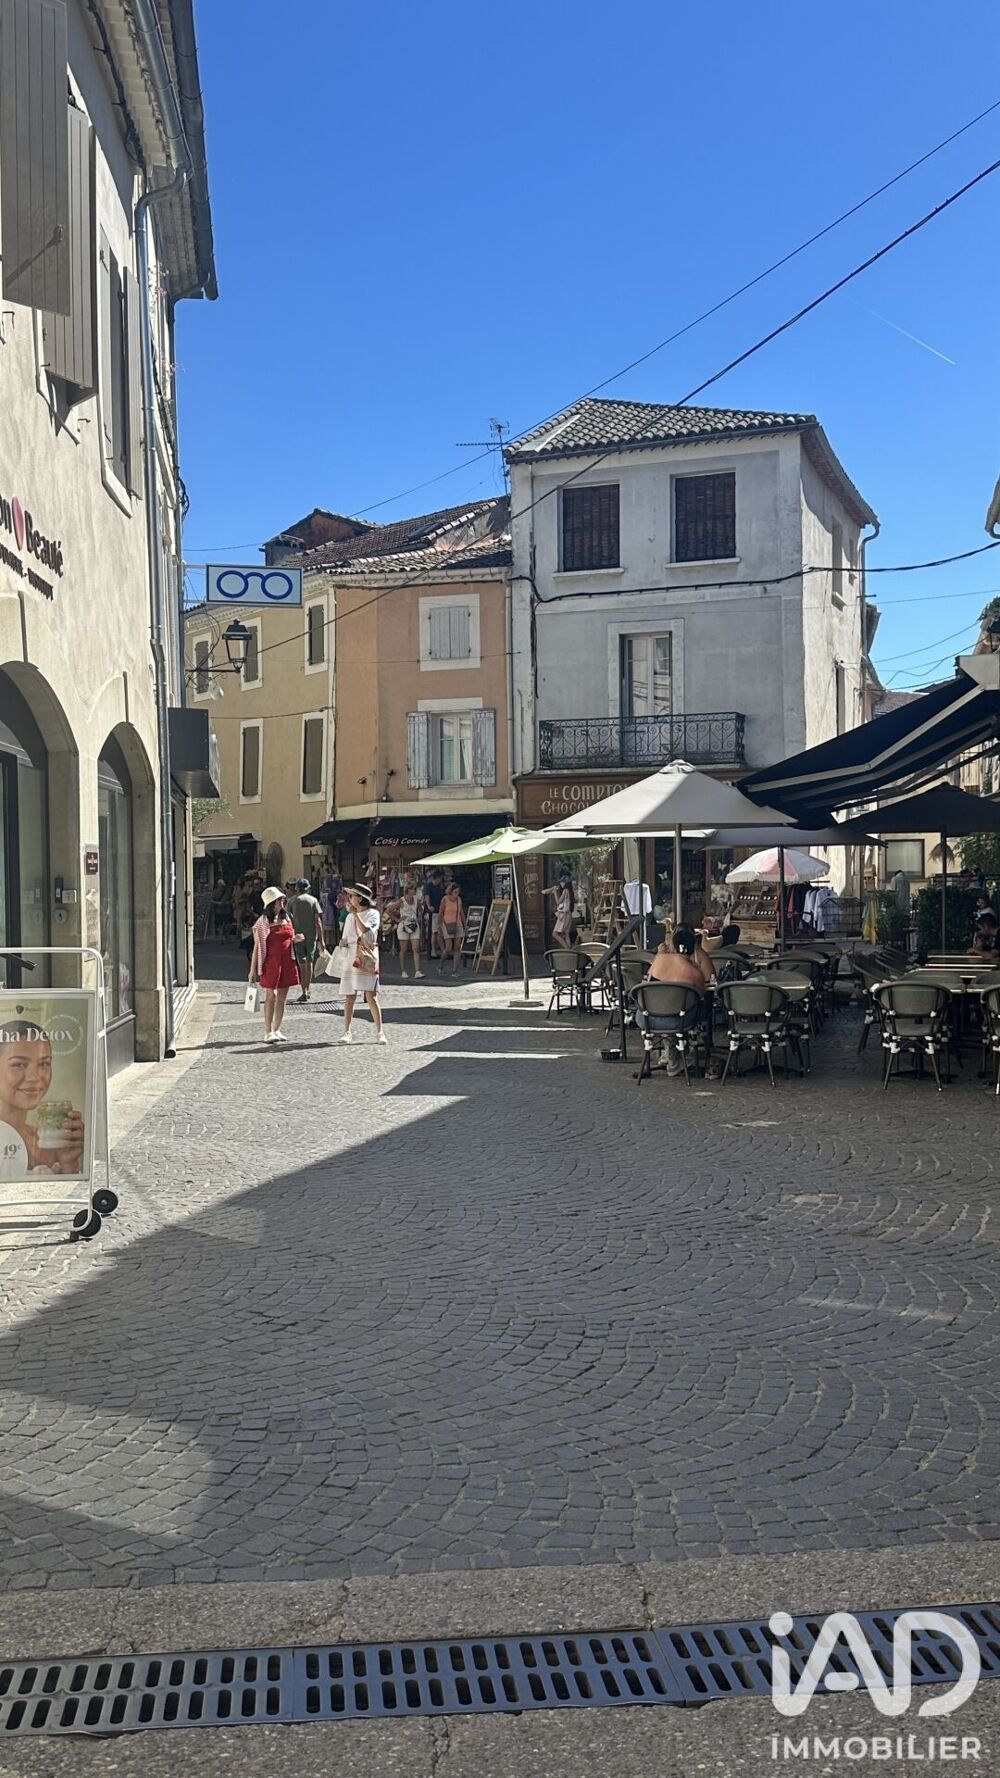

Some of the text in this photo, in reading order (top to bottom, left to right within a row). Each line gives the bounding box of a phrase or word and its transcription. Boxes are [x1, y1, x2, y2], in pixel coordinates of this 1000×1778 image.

[24, 510, 64, 578] Beauté
[549, 783, 629, 801] LE COMPTO
[374, 836, 400, 847] Cosy
[26, 1027, 73, 1042] Detox
